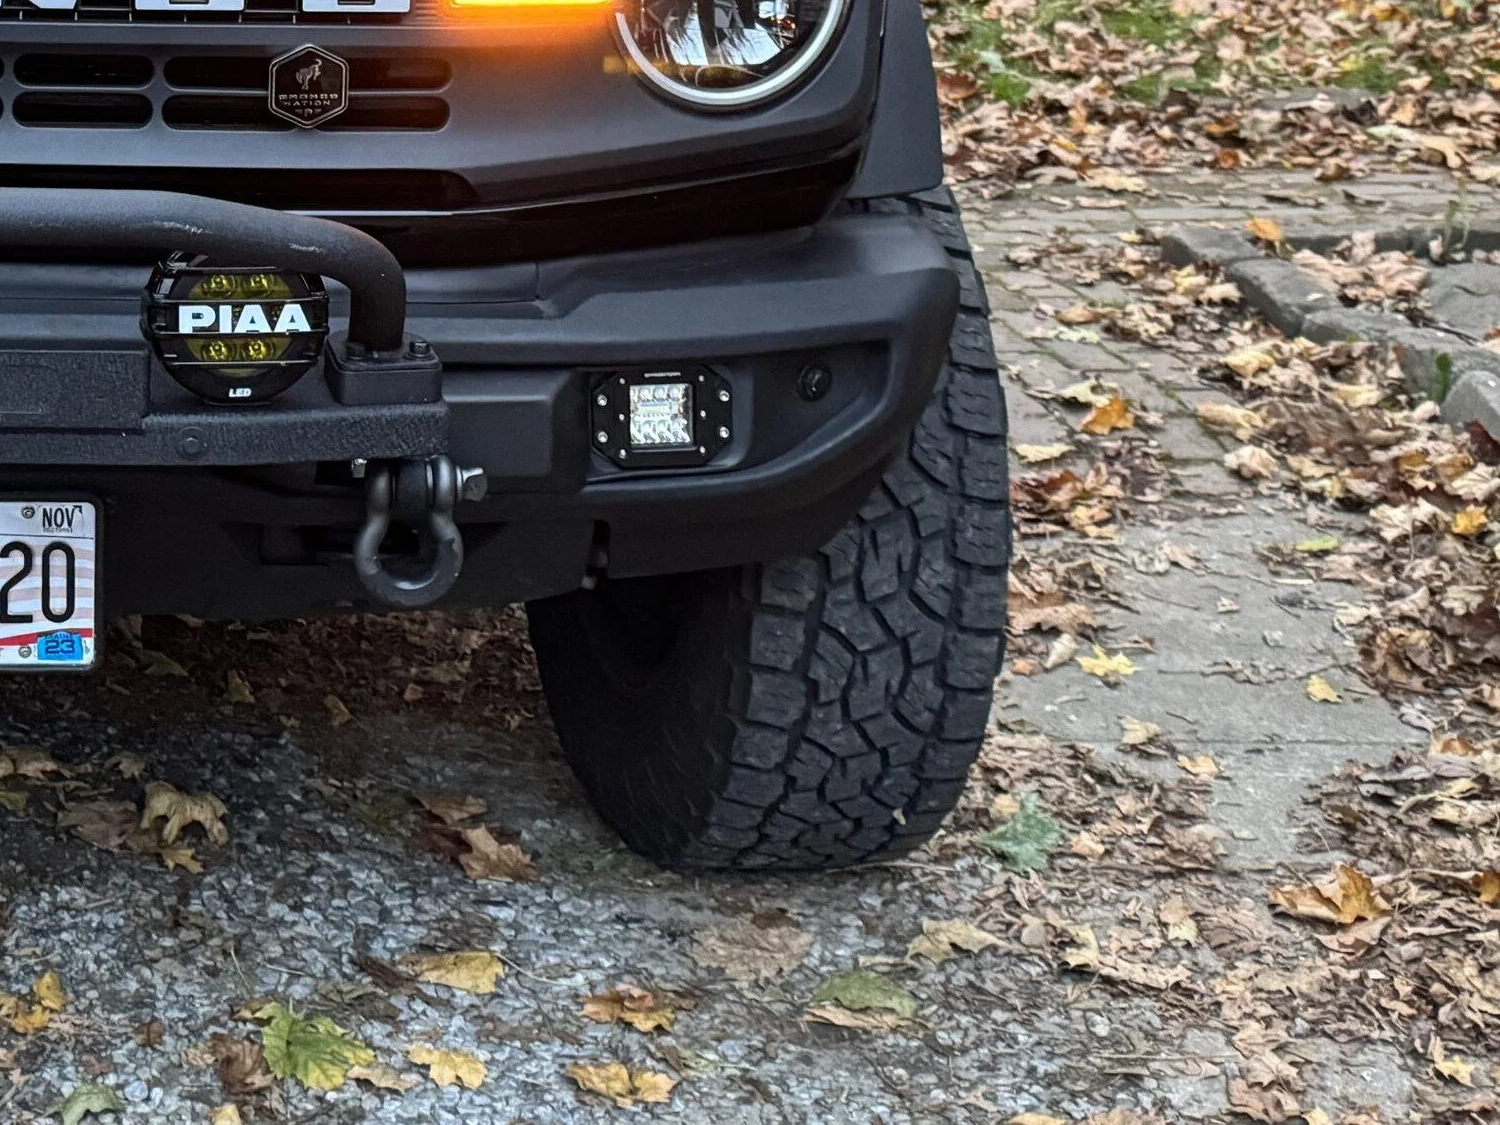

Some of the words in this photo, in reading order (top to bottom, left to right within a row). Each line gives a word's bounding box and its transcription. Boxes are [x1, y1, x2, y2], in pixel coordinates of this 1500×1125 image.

[178, 303, 312, 334] PIAA
[42, 507, 76, 528] NOV
[45, 639, 76, 654] 23
